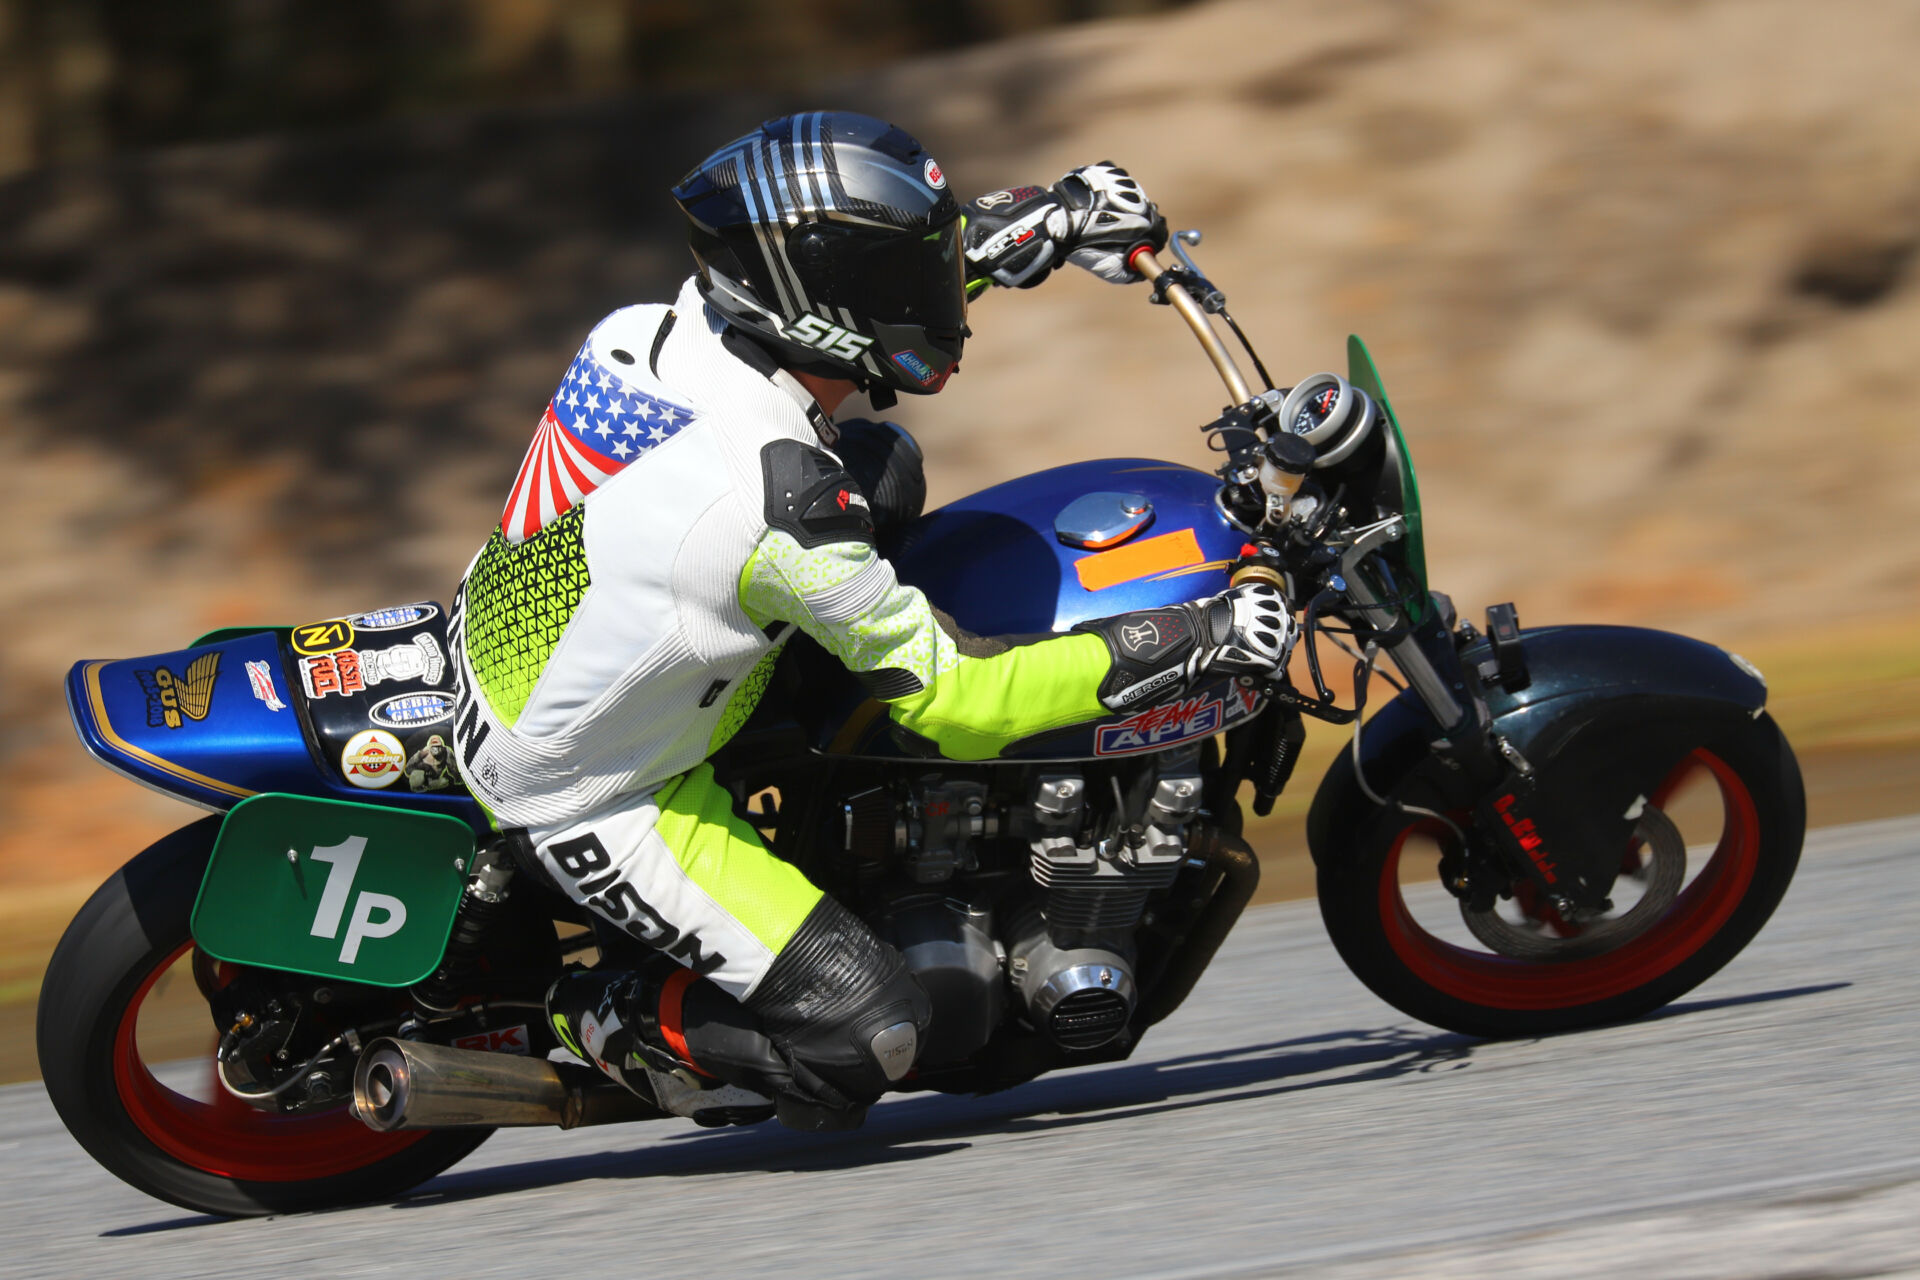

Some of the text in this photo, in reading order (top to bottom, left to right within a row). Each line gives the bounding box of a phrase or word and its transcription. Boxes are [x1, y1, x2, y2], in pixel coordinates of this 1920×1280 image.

[786, 313, 875, 361] 515
[308, 656, 340, 697] FUEL
[334, 650, 363, 695] FOSSIL
[362, 651, 377, 683] RACING
[155, 668, 181, 729] GUS
[389, 696, 443, 712] REBEL
[1122, 670, 1180, 705] HEROIC
[391, 706, 445, 722] GEARS
[1110, 710, 1211, 748] APE
[1119, 693, 1208, 737] TEAM
[925, 802, 949, 816] CR
[548, 832, 727, 976] BISON
[456, 1026, 524, 1052] RK
